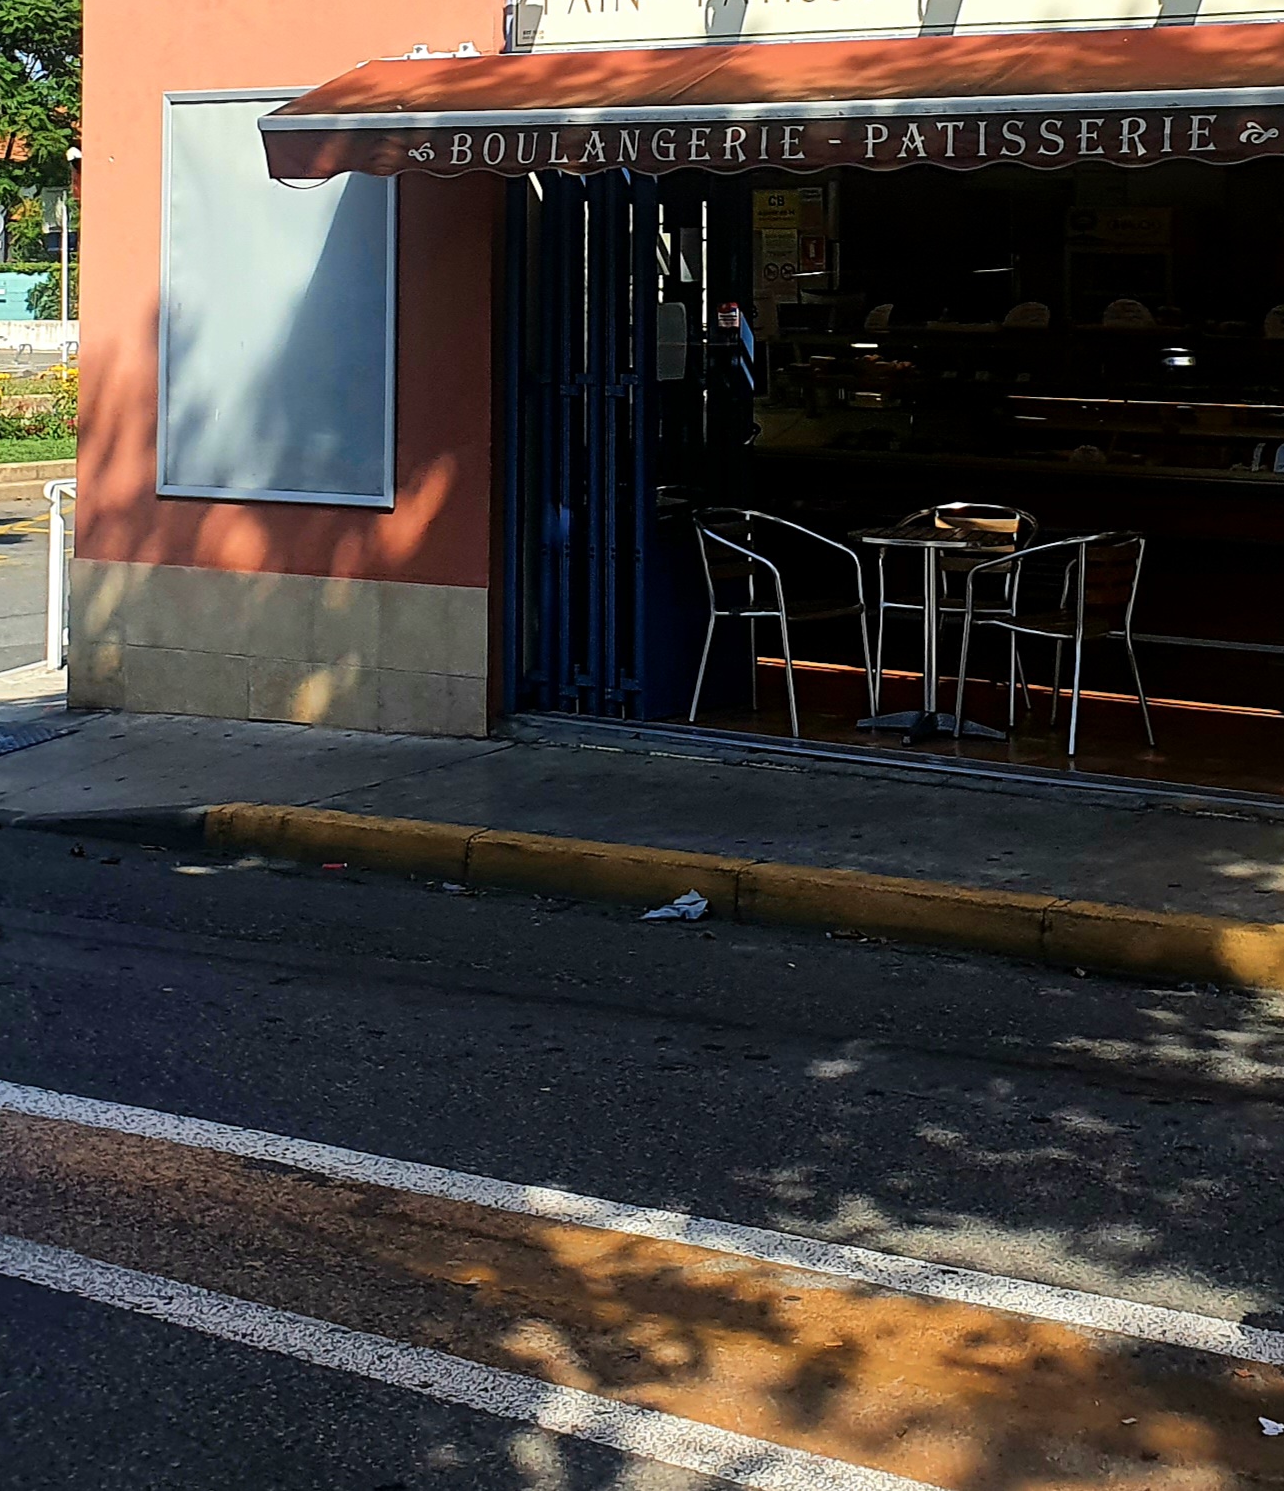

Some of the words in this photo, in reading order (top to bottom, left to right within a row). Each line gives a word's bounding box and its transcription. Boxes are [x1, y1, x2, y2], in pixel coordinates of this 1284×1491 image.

[450, 124, 807, 166] BOULANGERIE
[863, 113, 1218, 159] PATISSERIE
[768, 195, 785, 207] CB
